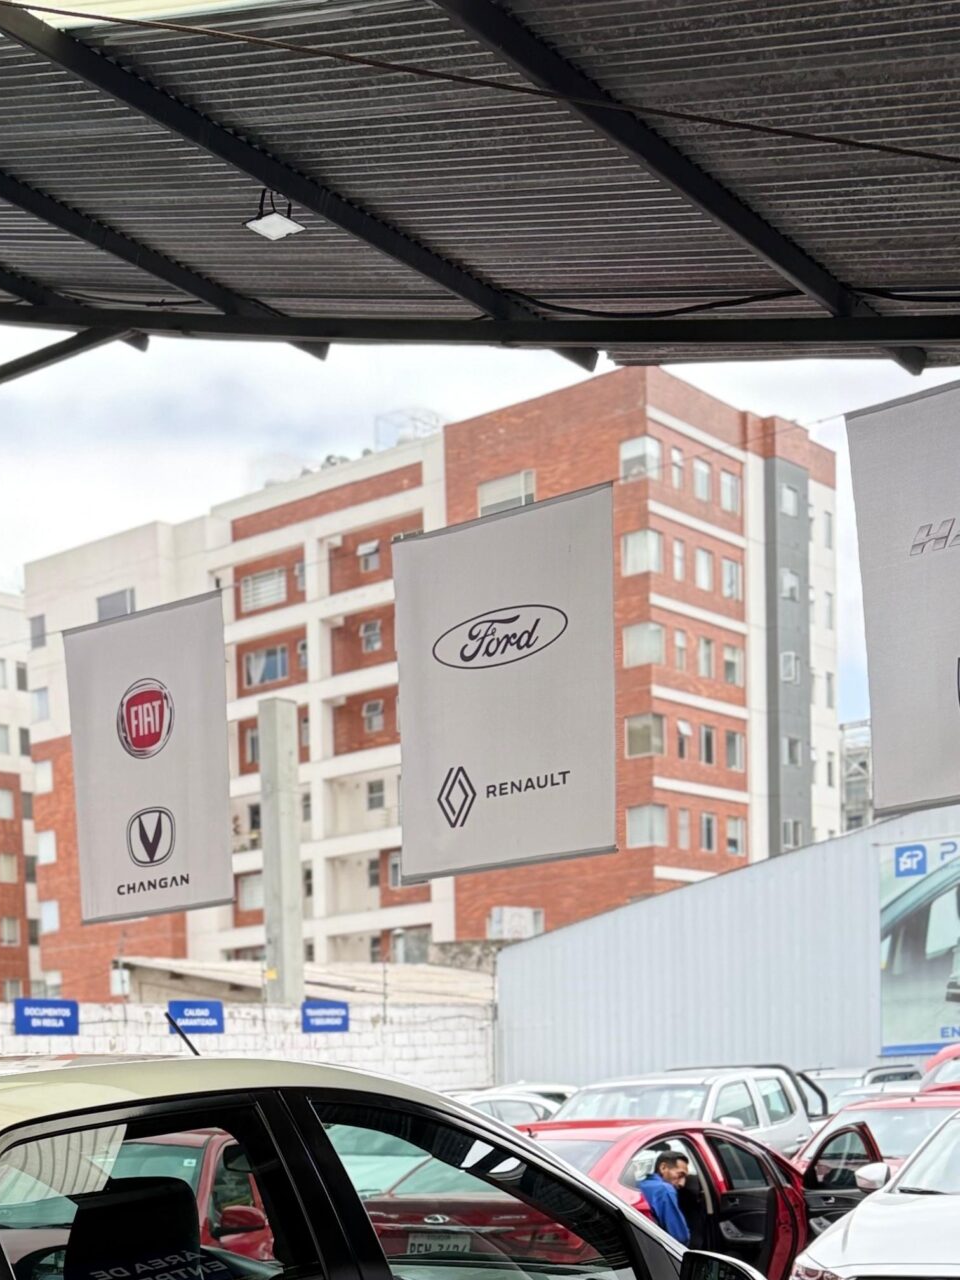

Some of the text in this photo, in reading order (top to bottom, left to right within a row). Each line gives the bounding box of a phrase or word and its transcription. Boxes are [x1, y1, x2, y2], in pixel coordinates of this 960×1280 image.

[459, 614, 541, 662] Ford
[129, 699, 162, 739] FIAT
[485, 769, 571, 799] RENAULT
[116, 873, 190, 896] CHANGAN
